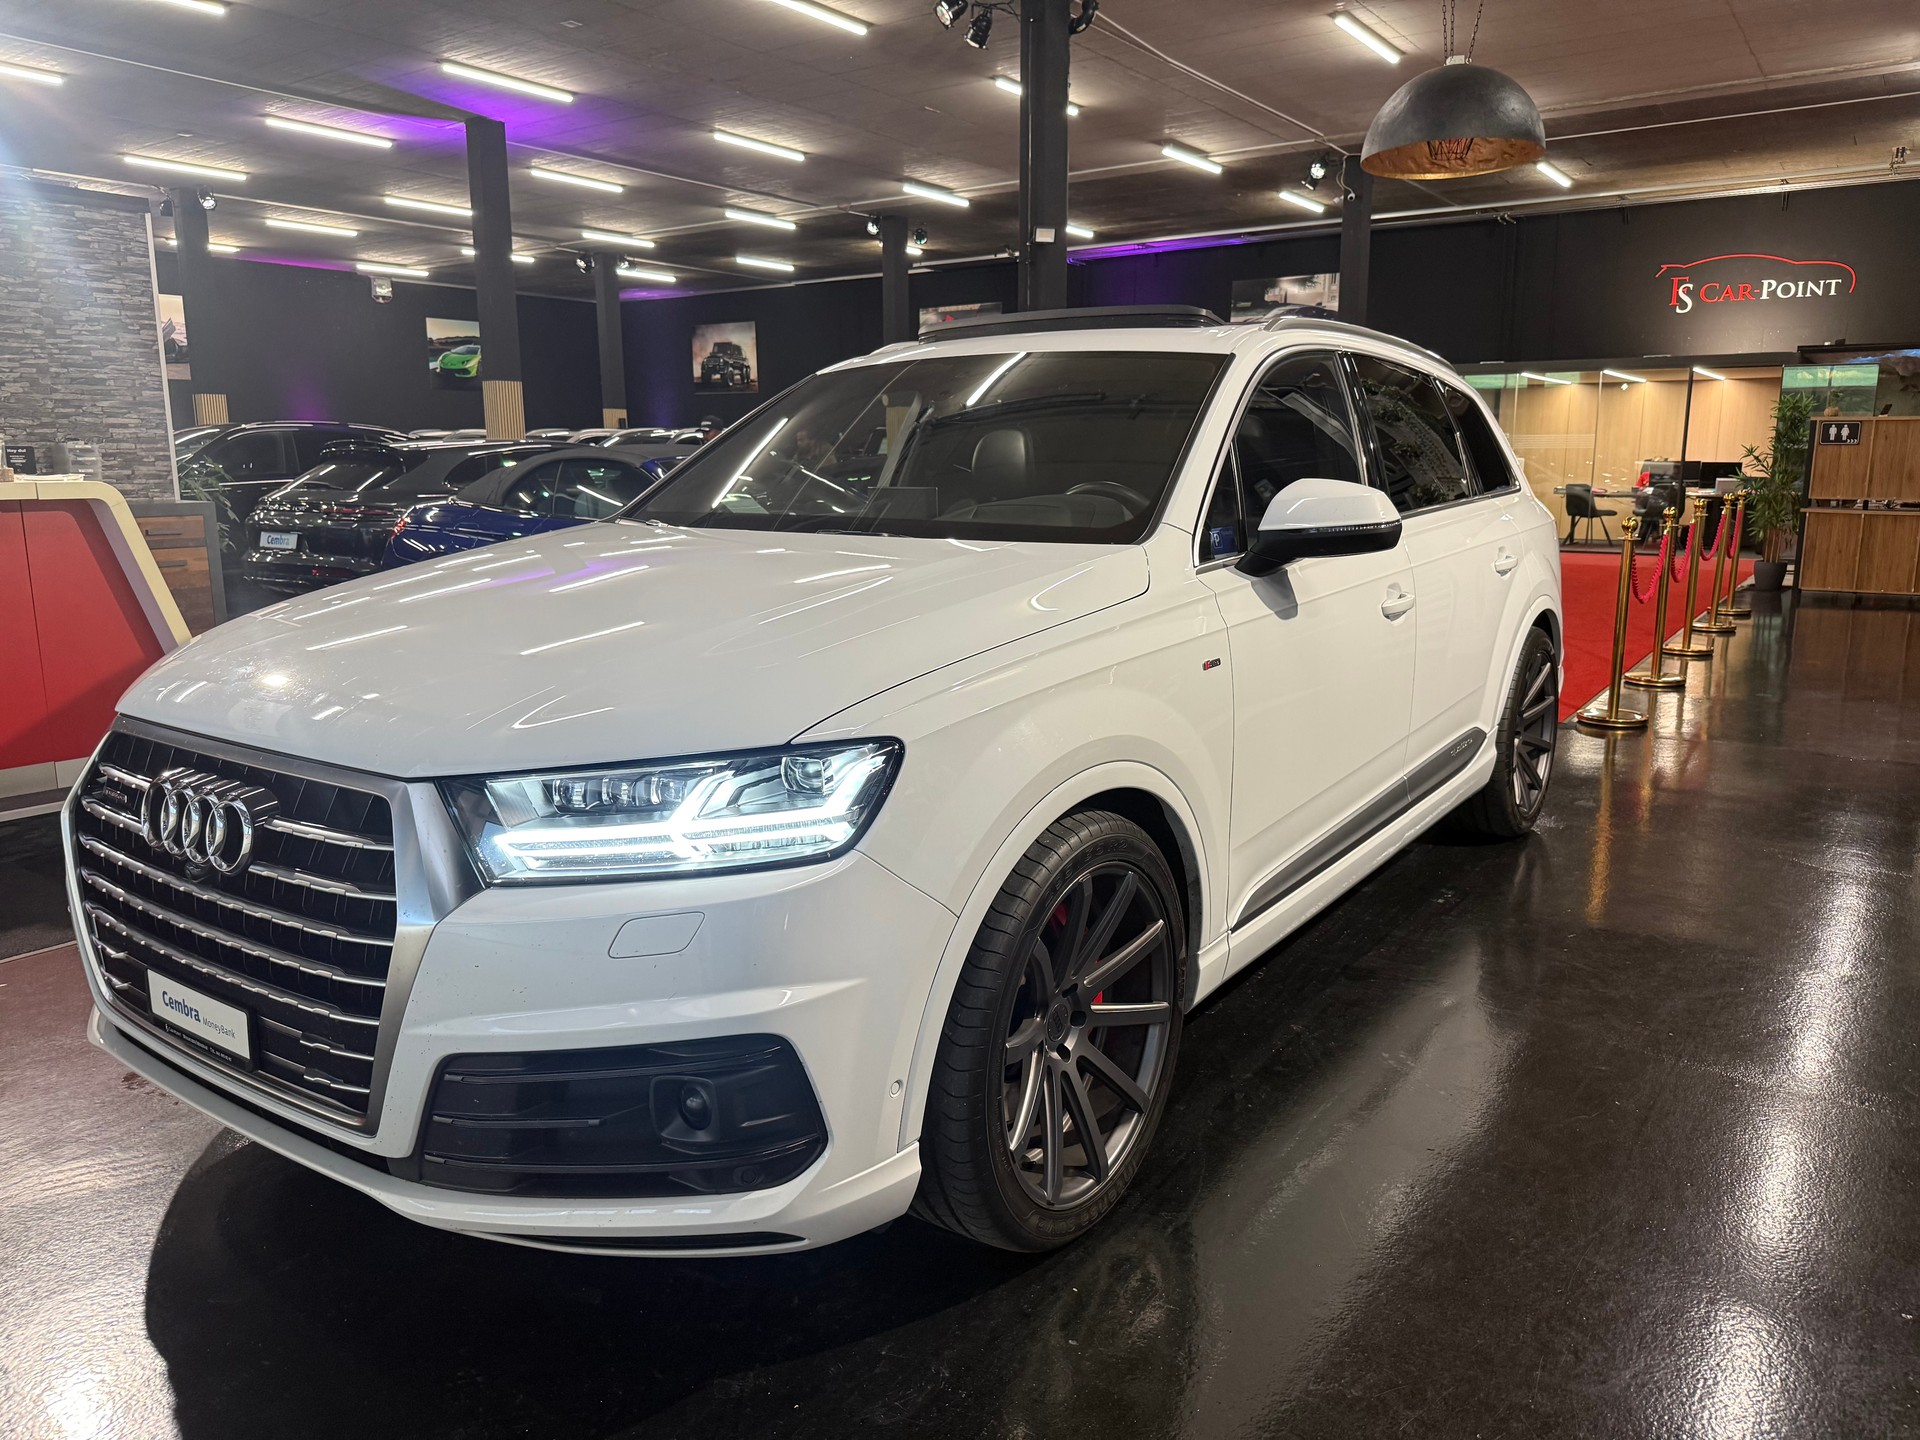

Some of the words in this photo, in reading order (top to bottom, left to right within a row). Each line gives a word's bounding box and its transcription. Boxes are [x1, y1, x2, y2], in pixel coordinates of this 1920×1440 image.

[1700, 279, 1842, 303] CAR-POINT
[267, 535, 290, 546] Cembra
[162, 990, 201, 1023] Cembra
[202, 1016, 236, 1039] MoneyBank
